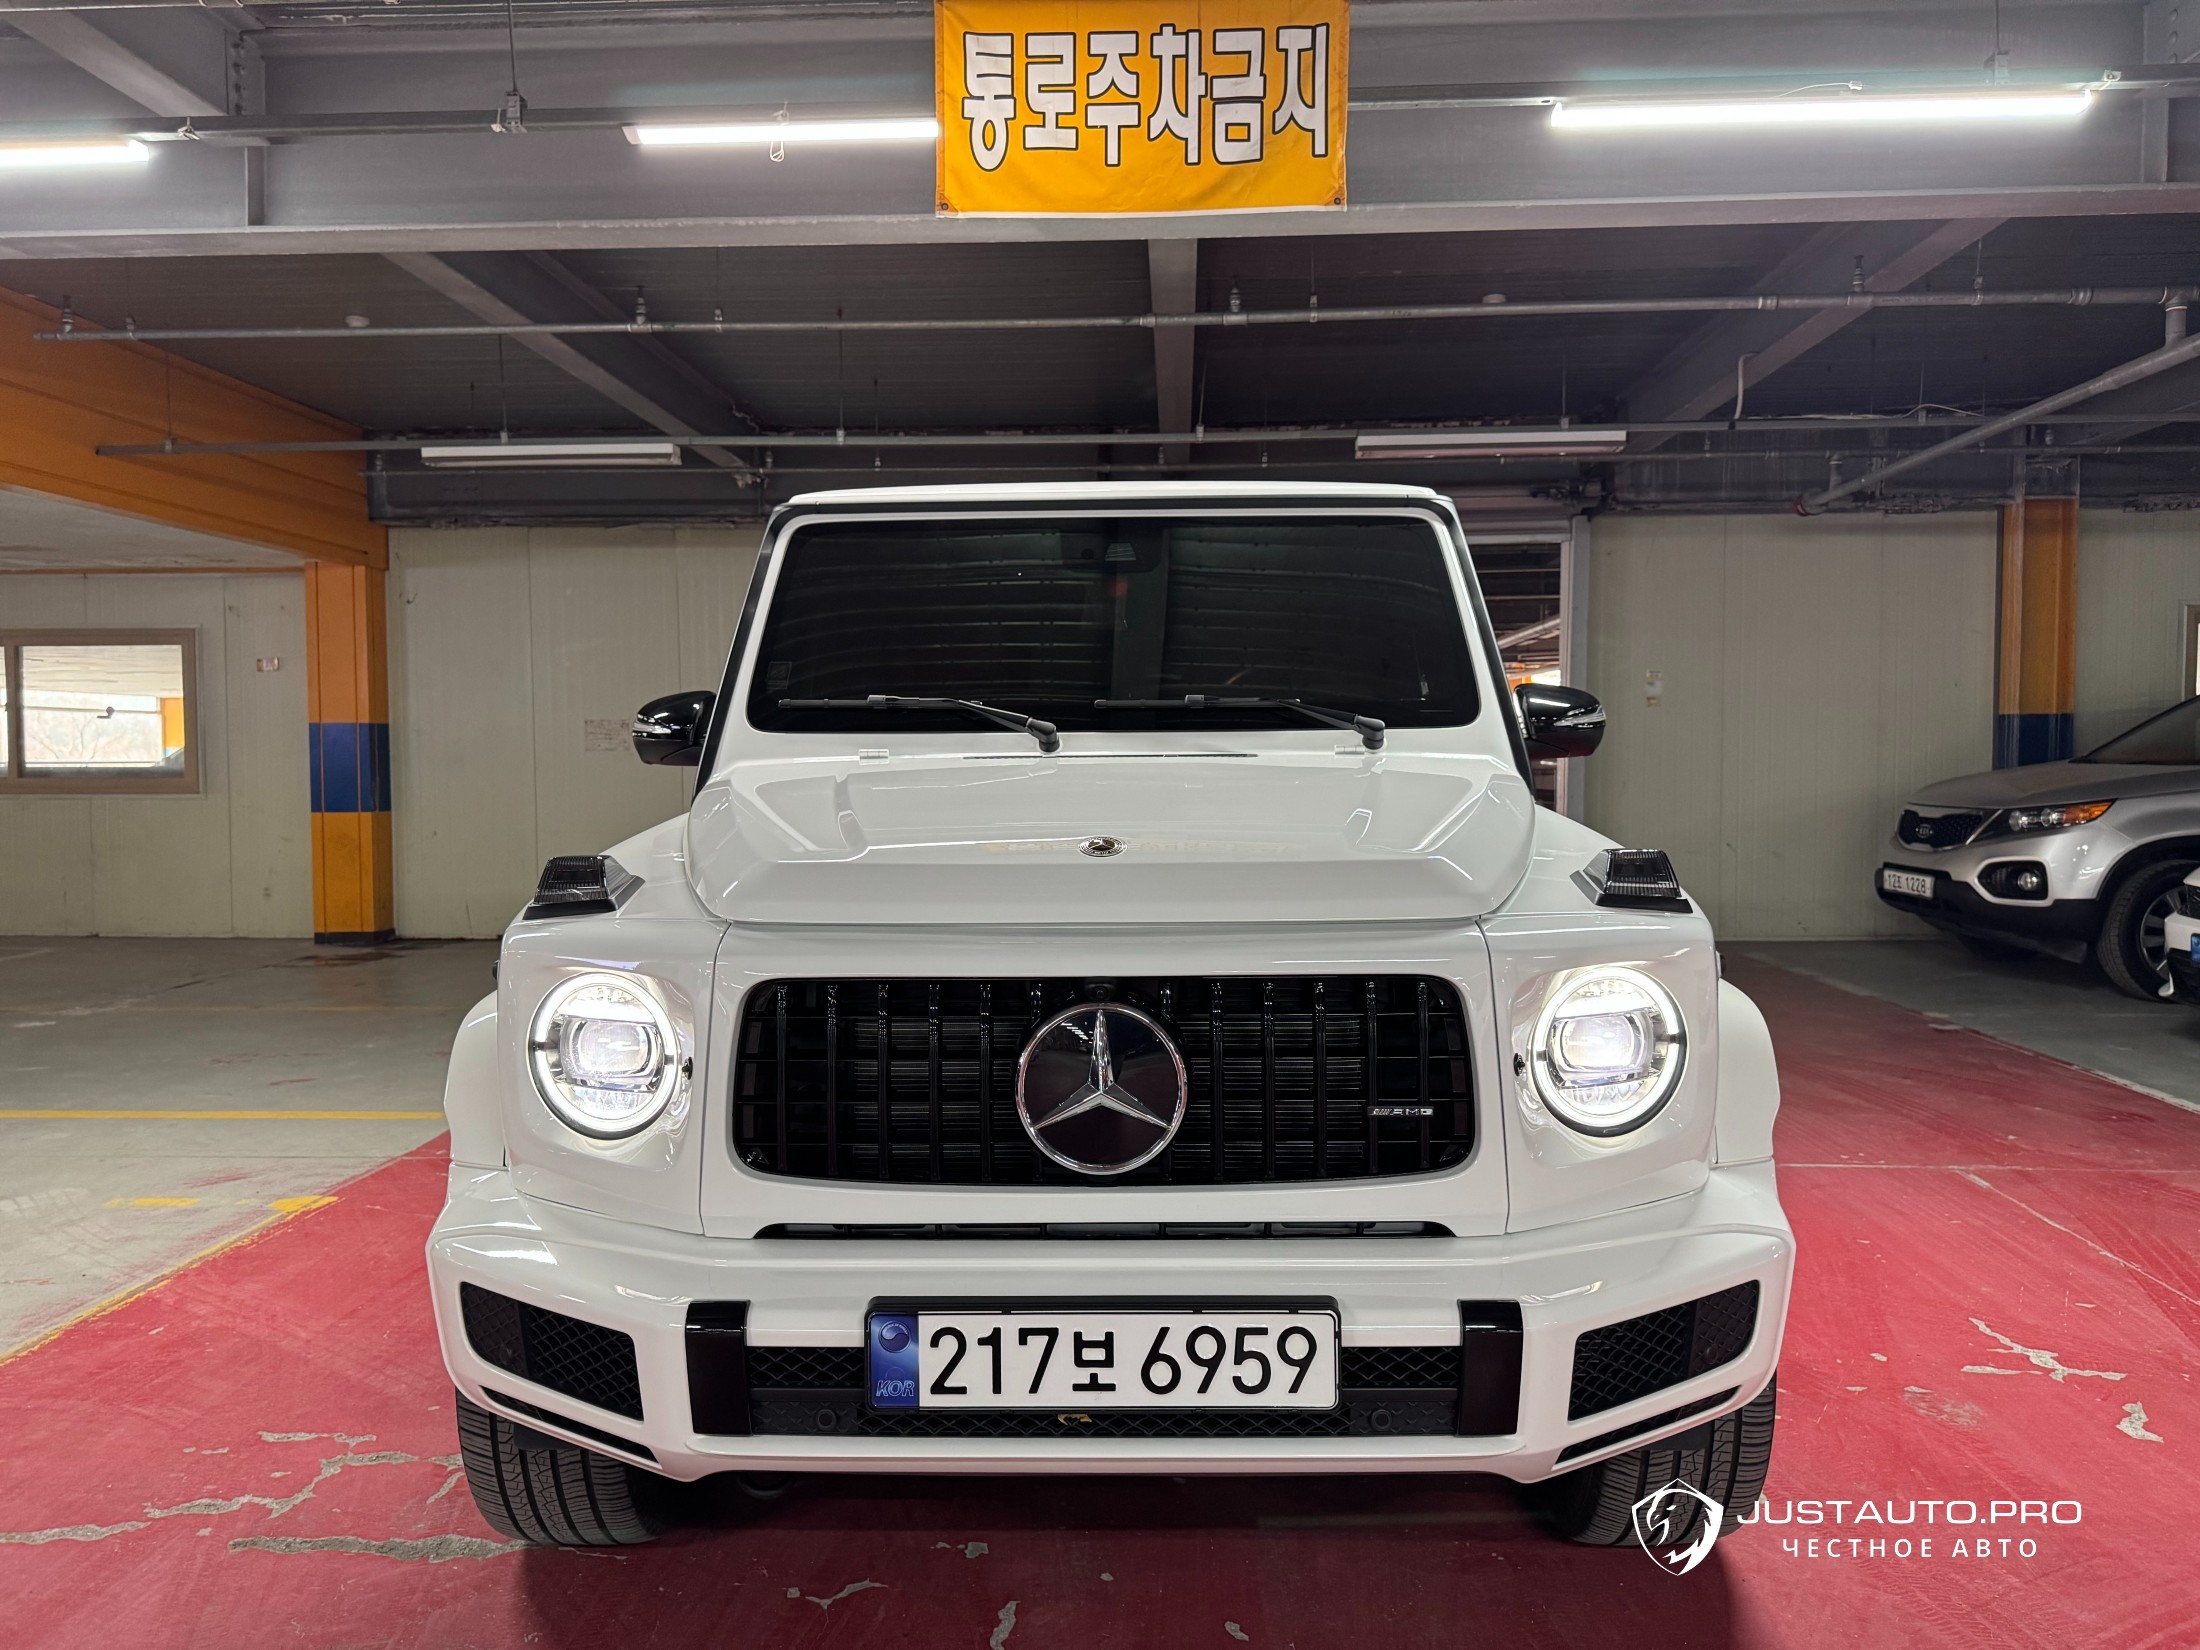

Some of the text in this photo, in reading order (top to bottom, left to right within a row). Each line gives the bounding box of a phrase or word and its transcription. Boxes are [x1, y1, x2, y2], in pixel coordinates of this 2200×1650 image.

[962, 23, 1330, 172] 통로주차금지
[1905, 876, 1926, 894] 1228
[929, 1326, 1318, 1395] 217보 6959
[876, 1379, 915, 1397] KOR
